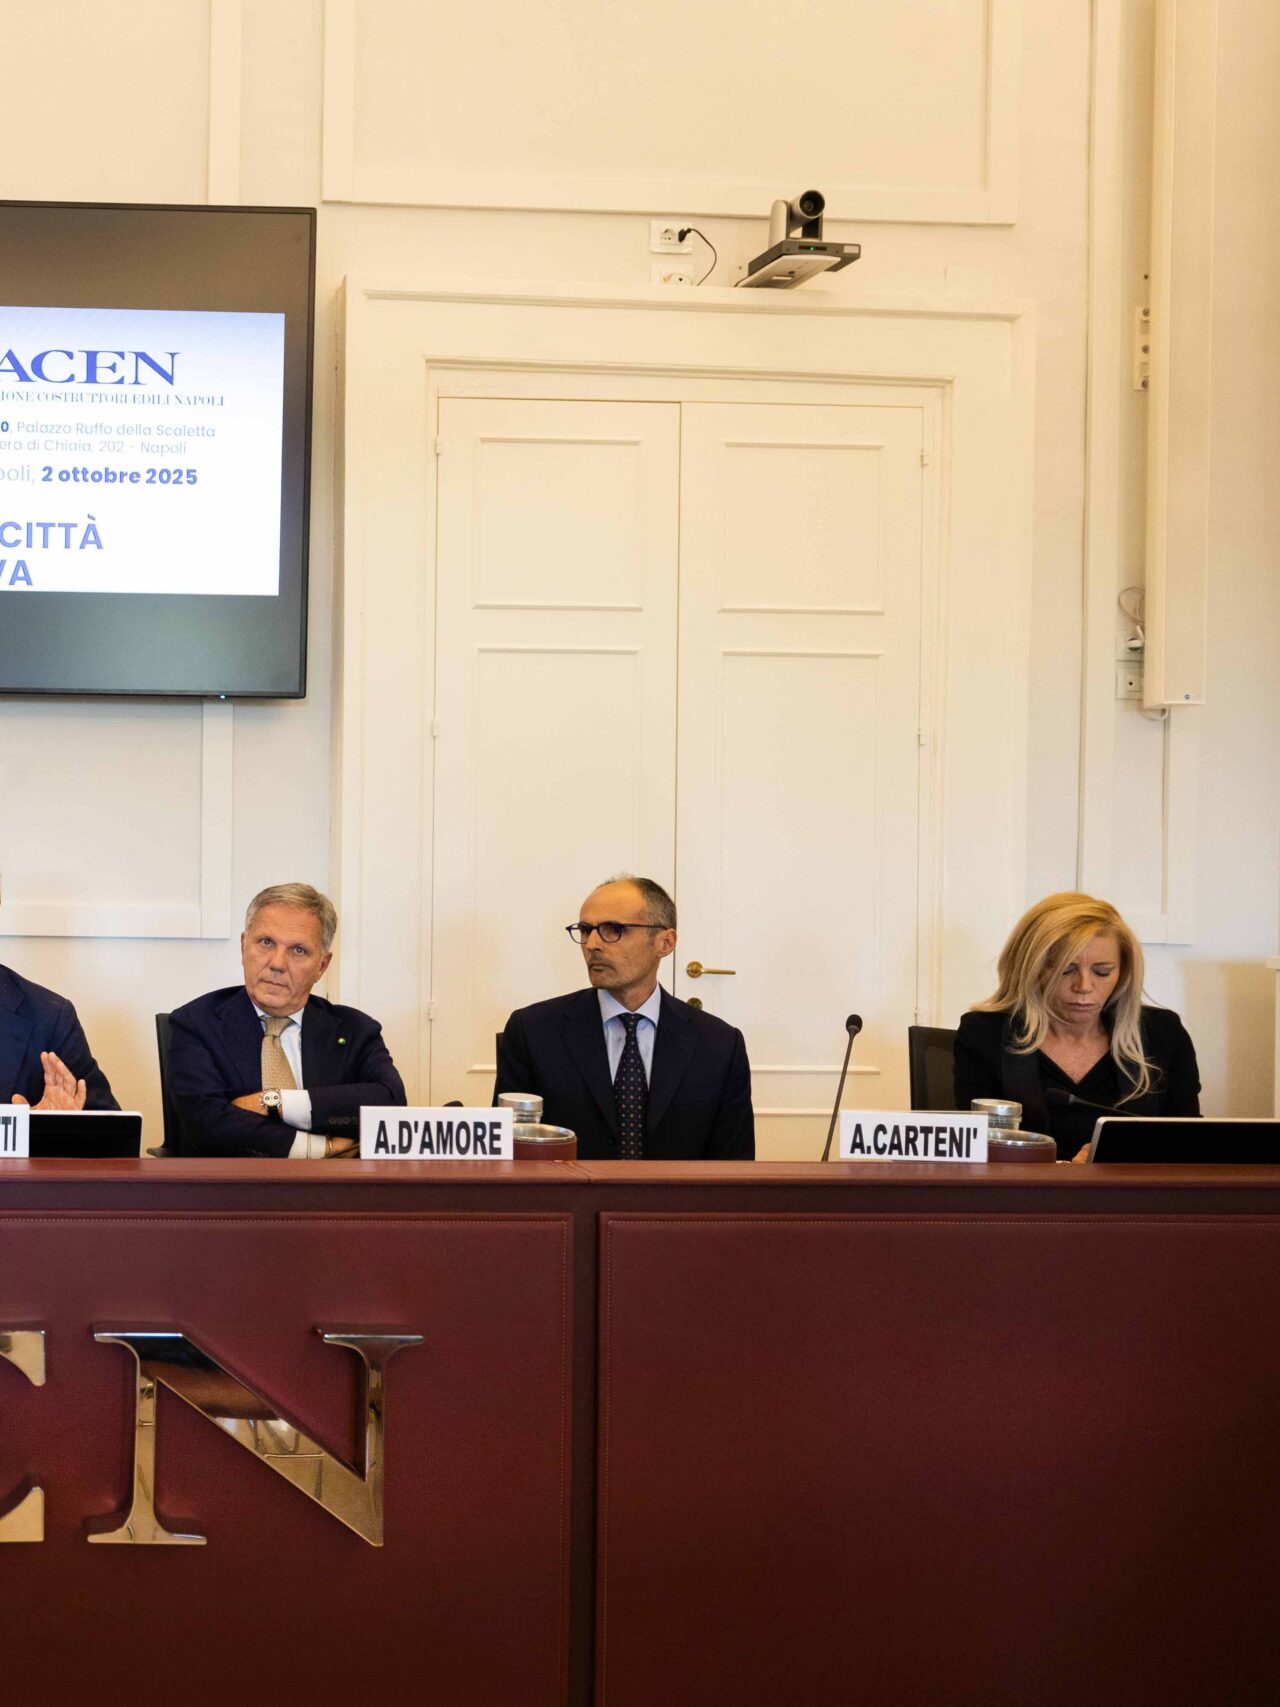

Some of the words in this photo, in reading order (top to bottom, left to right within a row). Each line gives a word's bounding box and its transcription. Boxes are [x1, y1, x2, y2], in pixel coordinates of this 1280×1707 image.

[37, 391, 129, 405] COSTRUTTORI
[133, 393, 170, 406] EDILI
[174, 394, 225, 407] NAPOLI
[17, 421, 72, 435] Palazzo
[75, 422, 113, 437] Ruffo
[116, 423, 152, 437] della
[156, 424, 216, 438] Scaletta
[27, 437, 40, 452] di
[44, 438, 95, 454] Chiaia,
[98, 440, 125, 453] 202
[140, 441, 187, 458] Napoli
[41, 466, 53, 483] 2
[58, 466, 141, 484] ottobre
[145, 468, 198, 485] 2025
[374, 1120, 502, 1155] A.D'AMORE
[849, 1123, 978, 1158] A.CARTENI'
